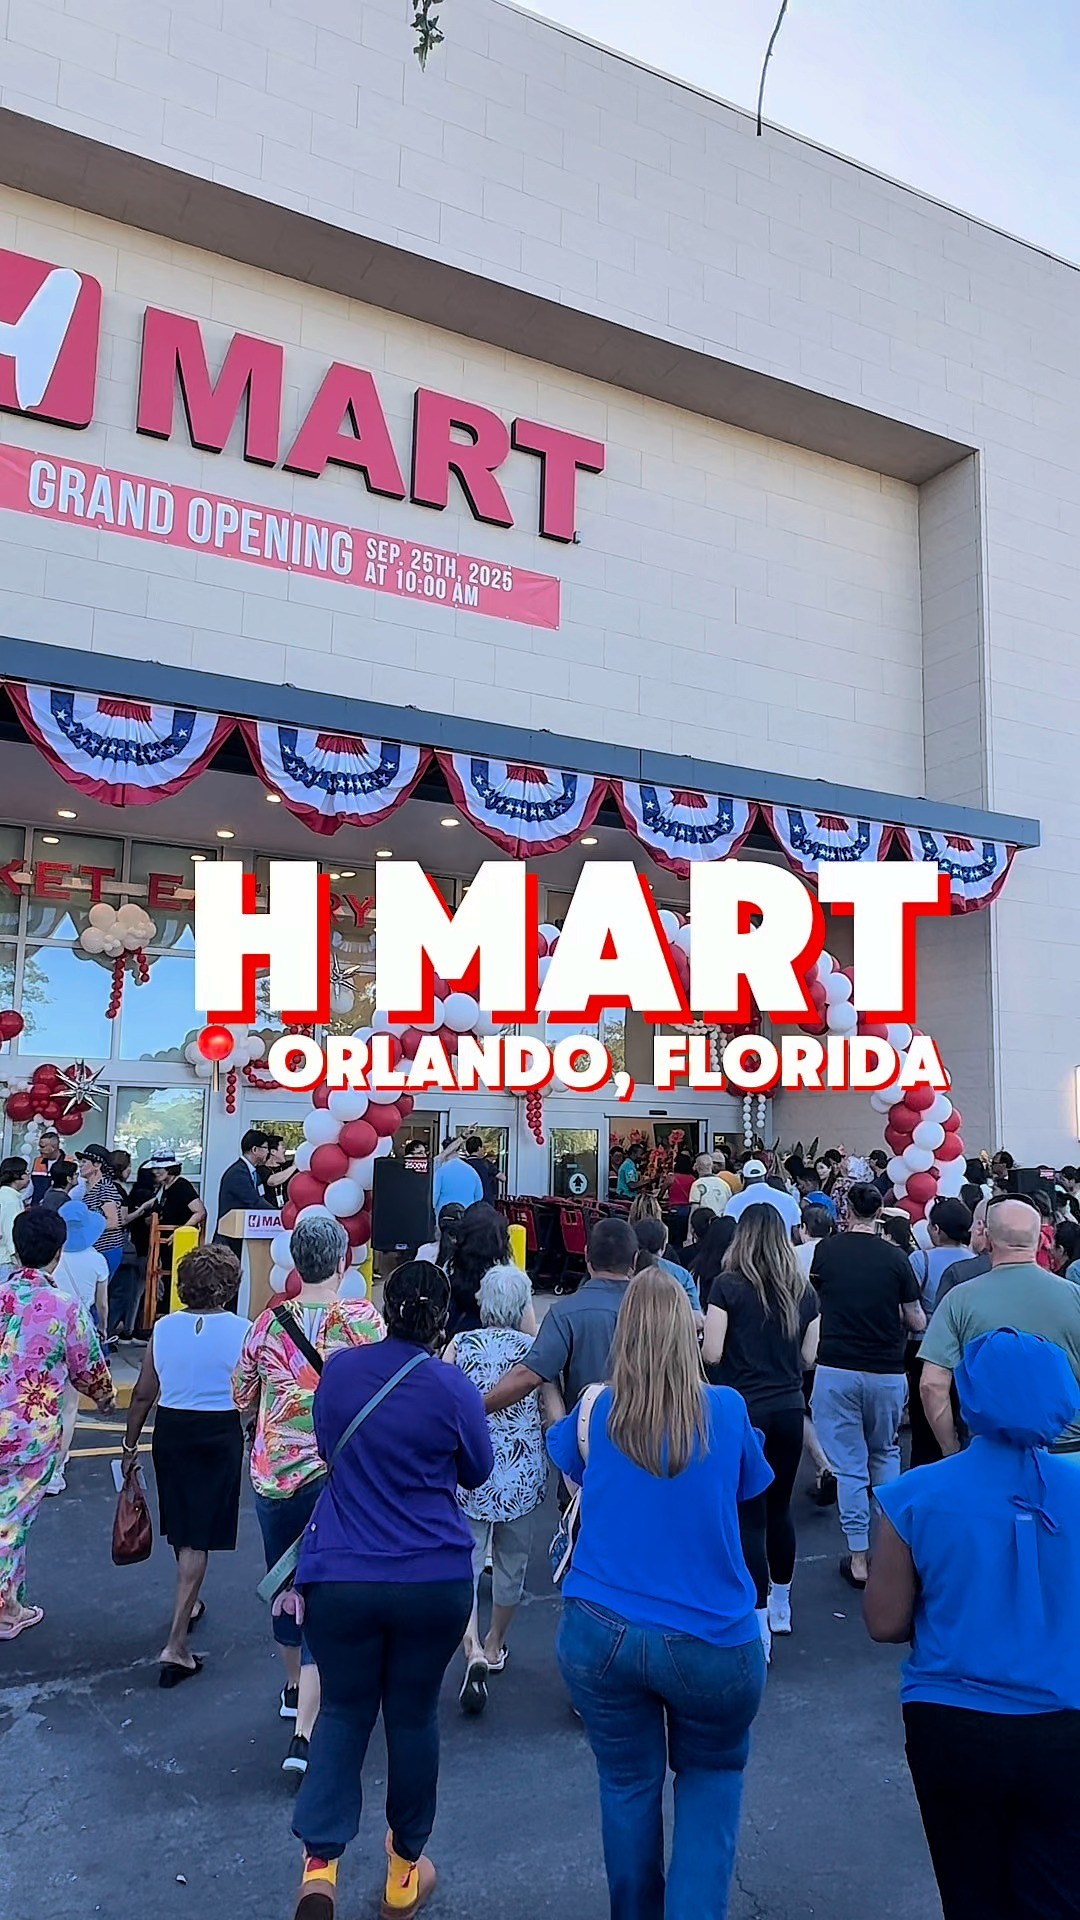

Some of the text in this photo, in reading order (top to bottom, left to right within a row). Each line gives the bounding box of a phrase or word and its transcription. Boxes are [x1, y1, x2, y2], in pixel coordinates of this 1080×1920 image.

[136, 306, 605, 545] MART
[28, 460, 353, 577] GRAND OPENING
[365, 562, 479, 607] AT 10:00 AM
[366, 537, 513, 592] SEP. 25TH, 2025
